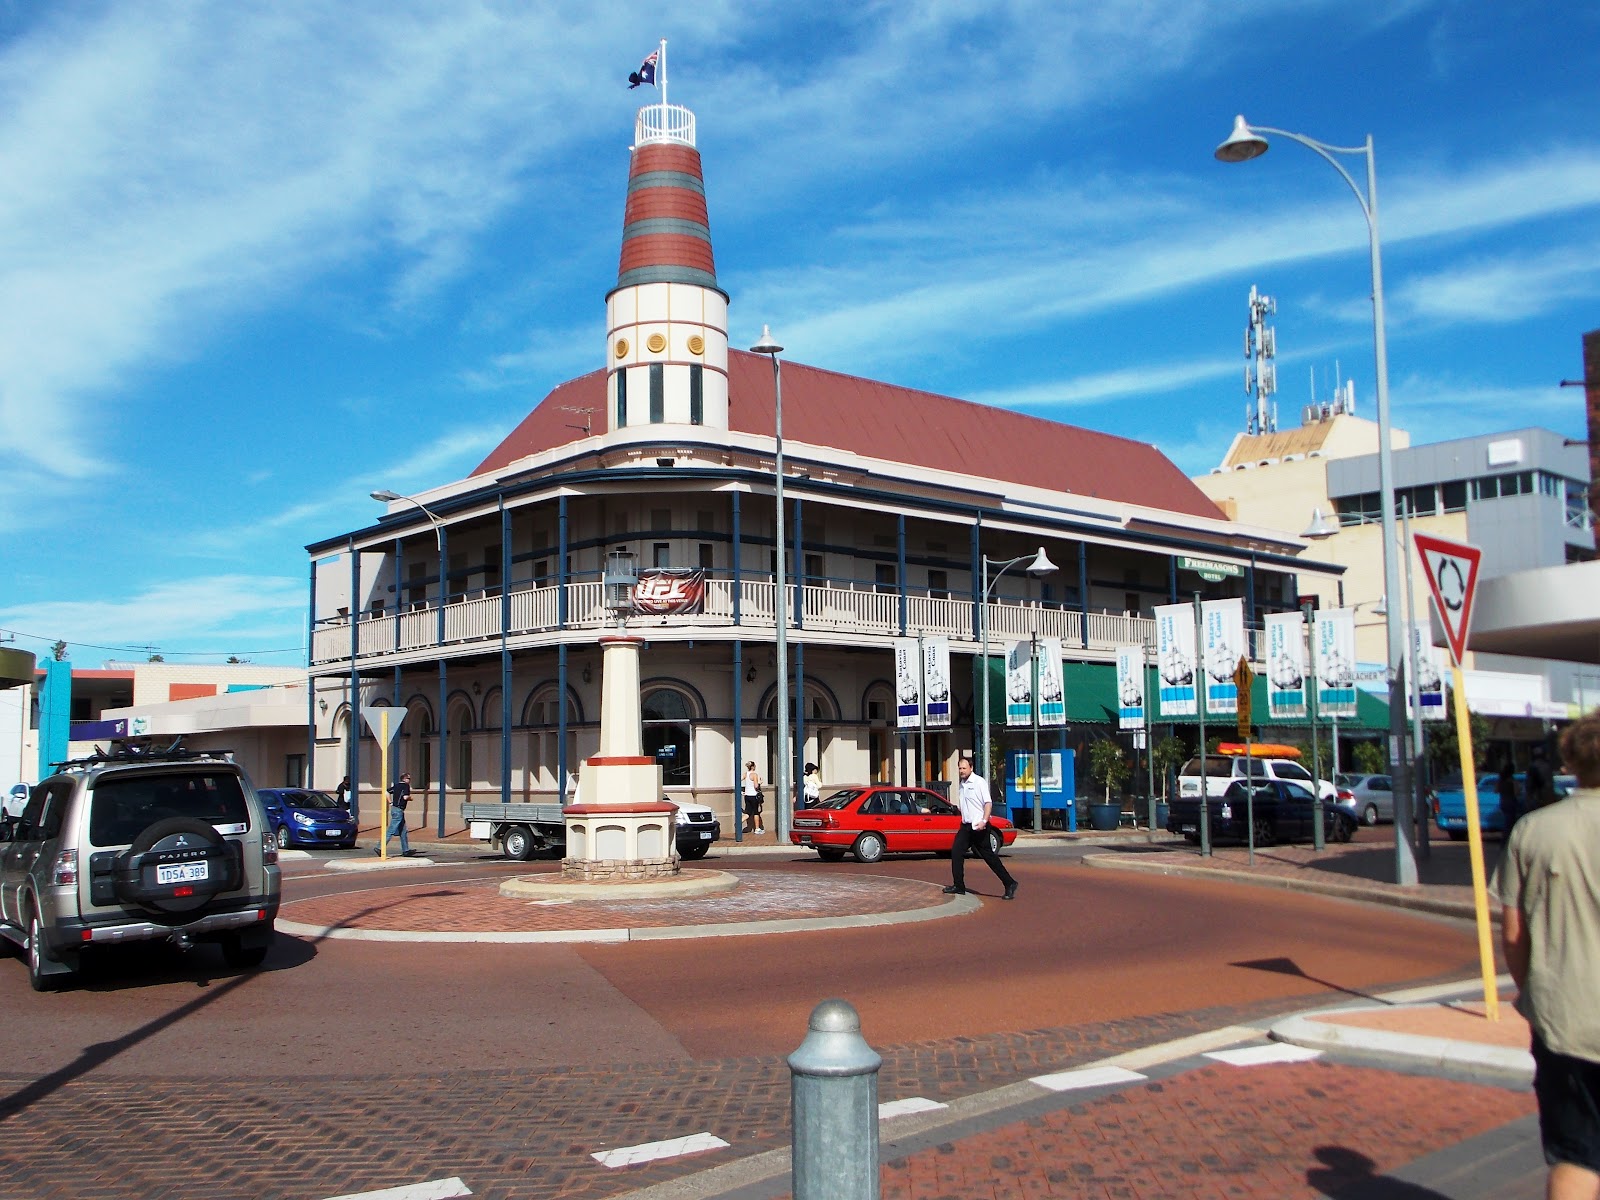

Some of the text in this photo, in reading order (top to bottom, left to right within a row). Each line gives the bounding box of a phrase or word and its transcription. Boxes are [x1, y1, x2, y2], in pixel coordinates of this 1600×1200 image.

[1184, 557, 1239, 574] FREEMASONS
[1203, 572, 1222, 580] HOTEL
[637, 579, 691, 600] UFC
[1338, 672, 1378, 681] DURLACHER
[159, 850, 207, 860] PAJERO
